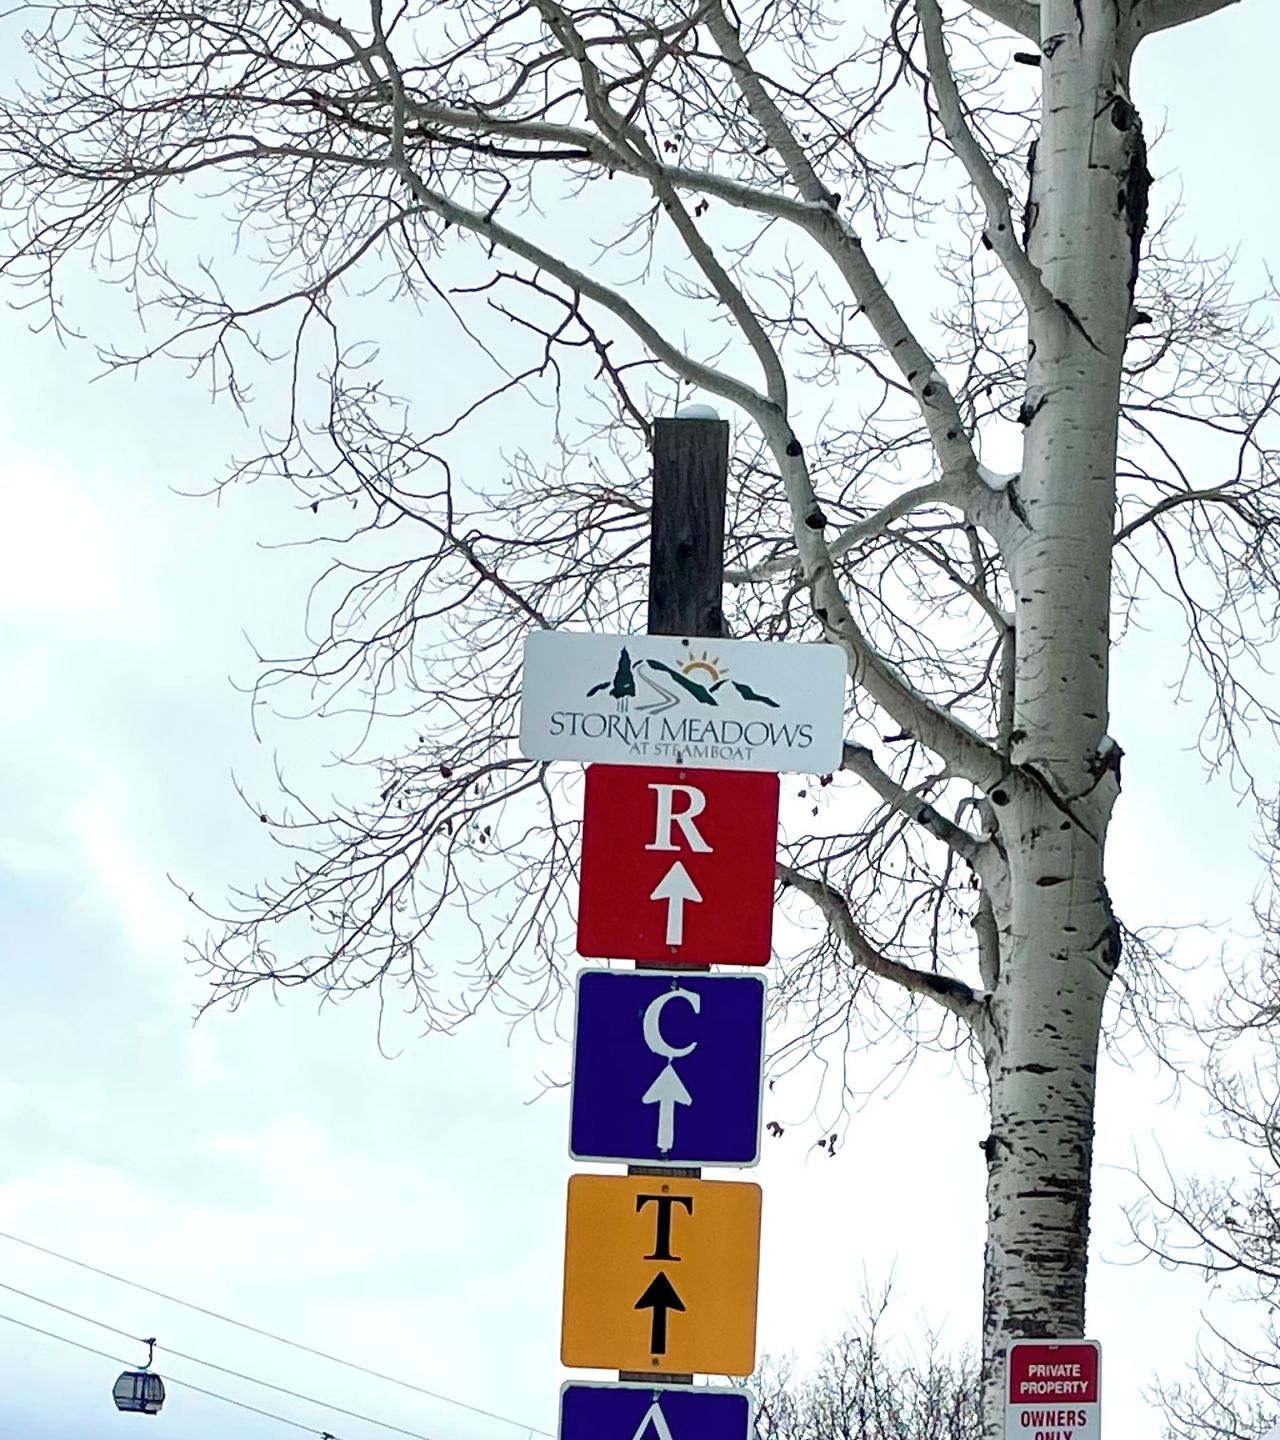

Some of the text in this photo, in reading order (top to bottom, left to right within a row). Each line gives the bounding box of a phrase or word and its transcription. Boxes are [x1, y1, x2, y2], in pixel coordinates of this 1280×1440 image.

[549, 712, 813, 748] STORM MEADOWS
[629, 742, 754, 761] AT STEAMBOAT
[644, 782, 714, 853] R
[642, 987, 701, 1058] C
[635, 1194, 693, 1262] T
[1028, 1364, 1081, 1377] PRIVATE
[1020, 1381, 1088, 1394] PROPERTY
[1021, 1410, 1087, 1427] OWNERS
